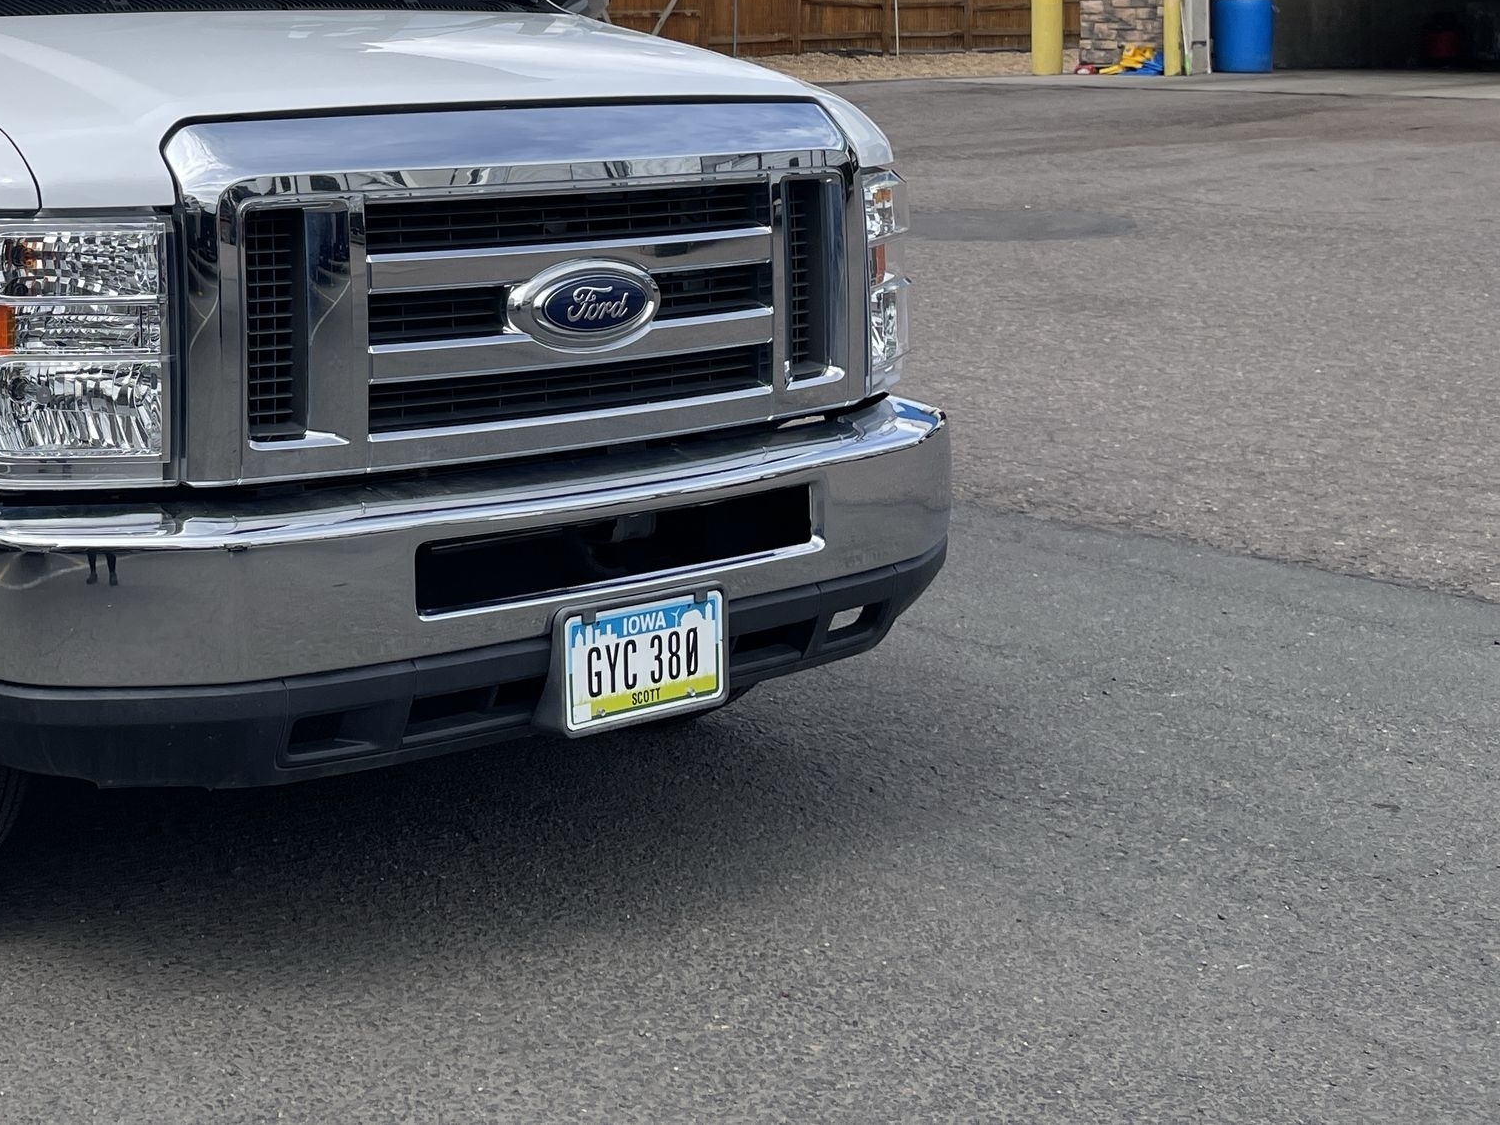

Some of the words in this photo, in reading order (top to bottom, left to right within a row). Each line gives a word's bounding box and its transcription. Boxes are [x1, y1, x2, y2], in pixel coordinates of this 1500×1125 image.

[567, 286, 628, 322] Ford
[622, 610, 667, 635] IOWA
[587, 639, 637, 698] GYC
[650, 626, 699, 685] 380
[632, 687, 661, 706] SCOTT
